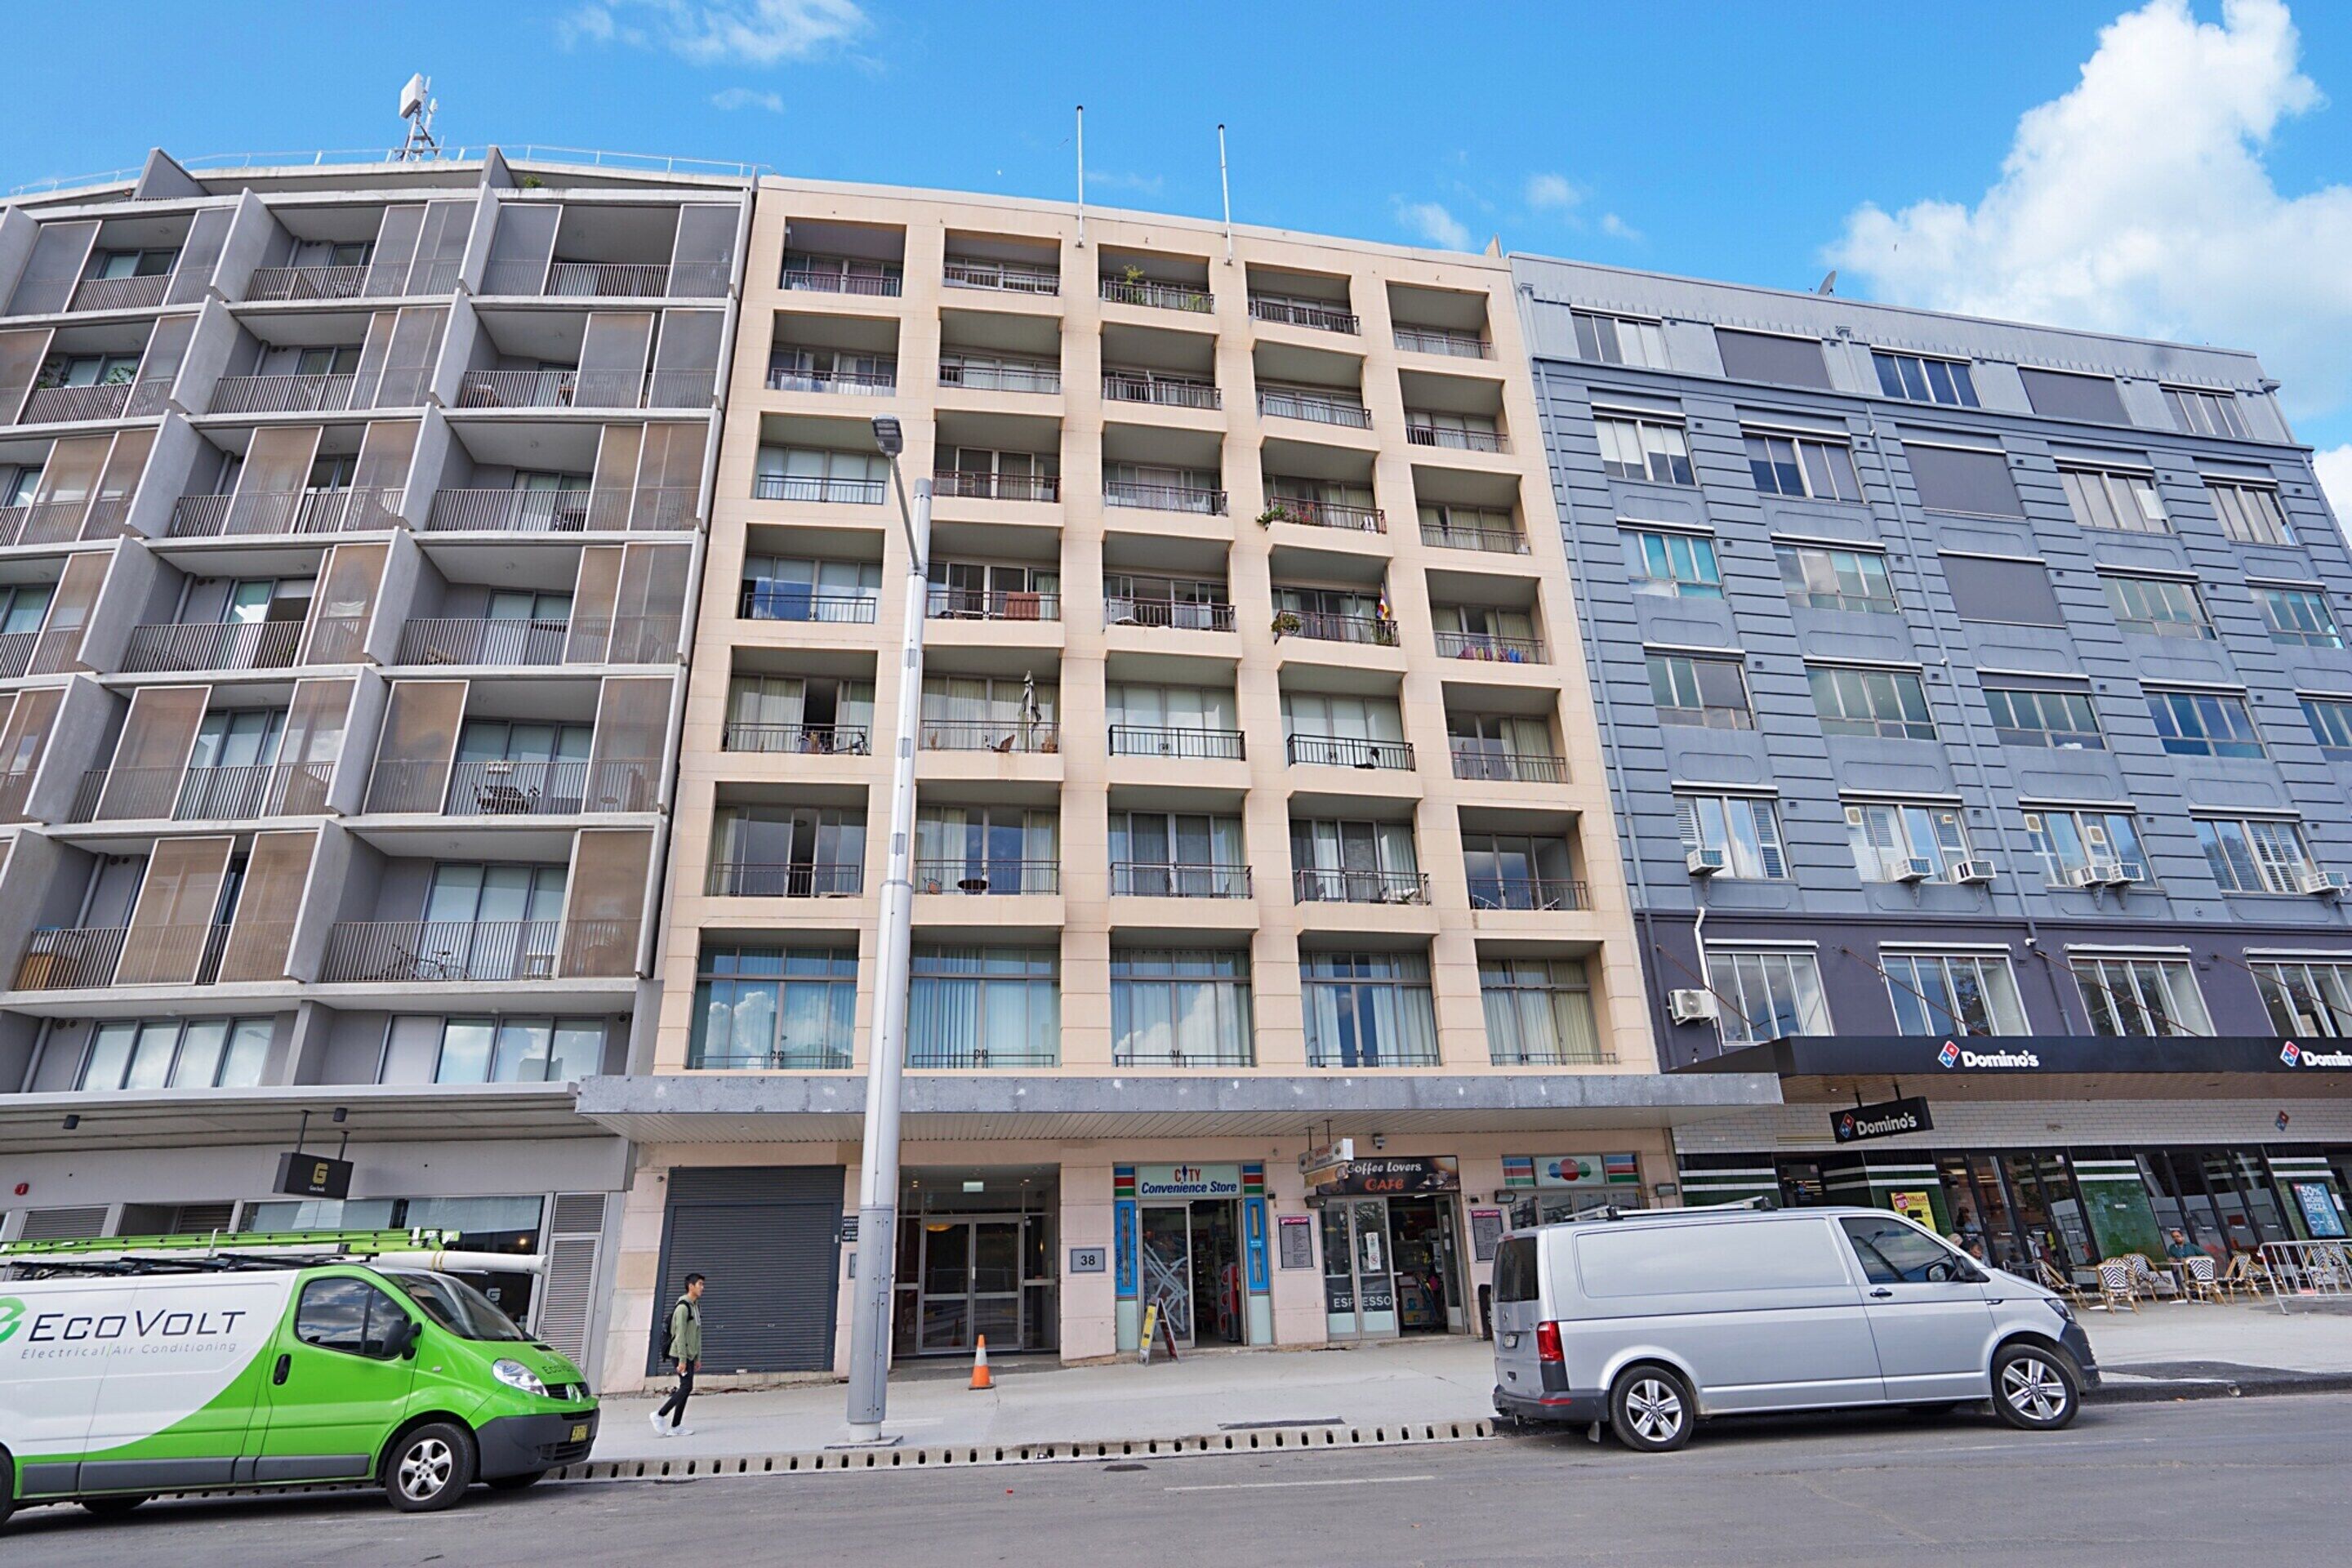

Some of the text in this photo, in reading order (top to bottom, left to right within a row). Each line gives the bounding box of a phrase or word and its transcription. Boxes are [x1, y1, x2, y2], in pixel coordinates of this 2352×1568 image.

[1961, 1049, 2040, 1067] Domino's
[1855, 1111, 1918, 1136] Domino's
[312, 1162, 328, 1184] G
[1174, 1165, 1201, 1183] CITY
[1347, 1160, 1383, 1176] Coffee
[1387, 1160, 1422, 1174] Lovers
[1141, 1180, 1237, 1194] Convenience Store
[1080, 1254, 1095, 1266] 38
[21, 1342, 237, 1360] Electrical Air Conditioning
